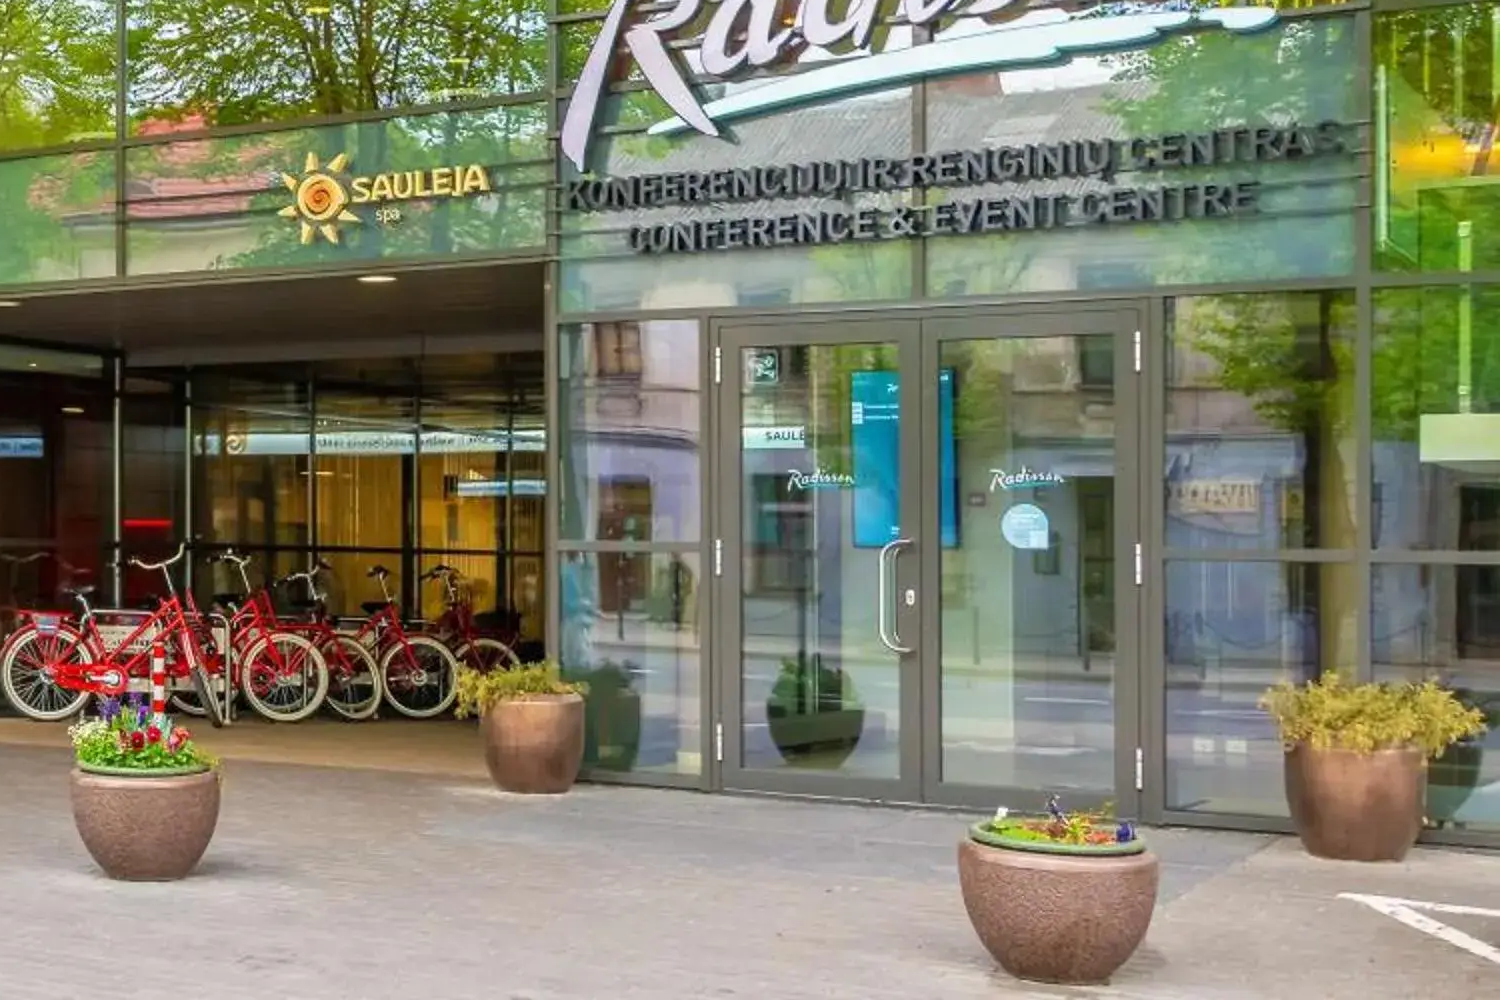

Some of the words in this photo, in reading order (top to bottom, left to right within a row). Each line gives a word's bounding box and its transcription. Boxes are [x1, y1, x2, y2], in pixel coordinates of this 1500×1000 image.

[1127, 119, 1347, 171] CENTRAS
[352, 164, 491, 203] SAULEJA
[375, 202, 401, 224] spa
[630, 206, 876, 255] CONFERENCE
[889, 205, 915, 236] &
[931, 192, 1062, 236] EVENT
[1078, 180, 1263, 226] CENTRE
[787, 466, 855, 491] Radisson
[989, 465, 1065, 492] Radisson
